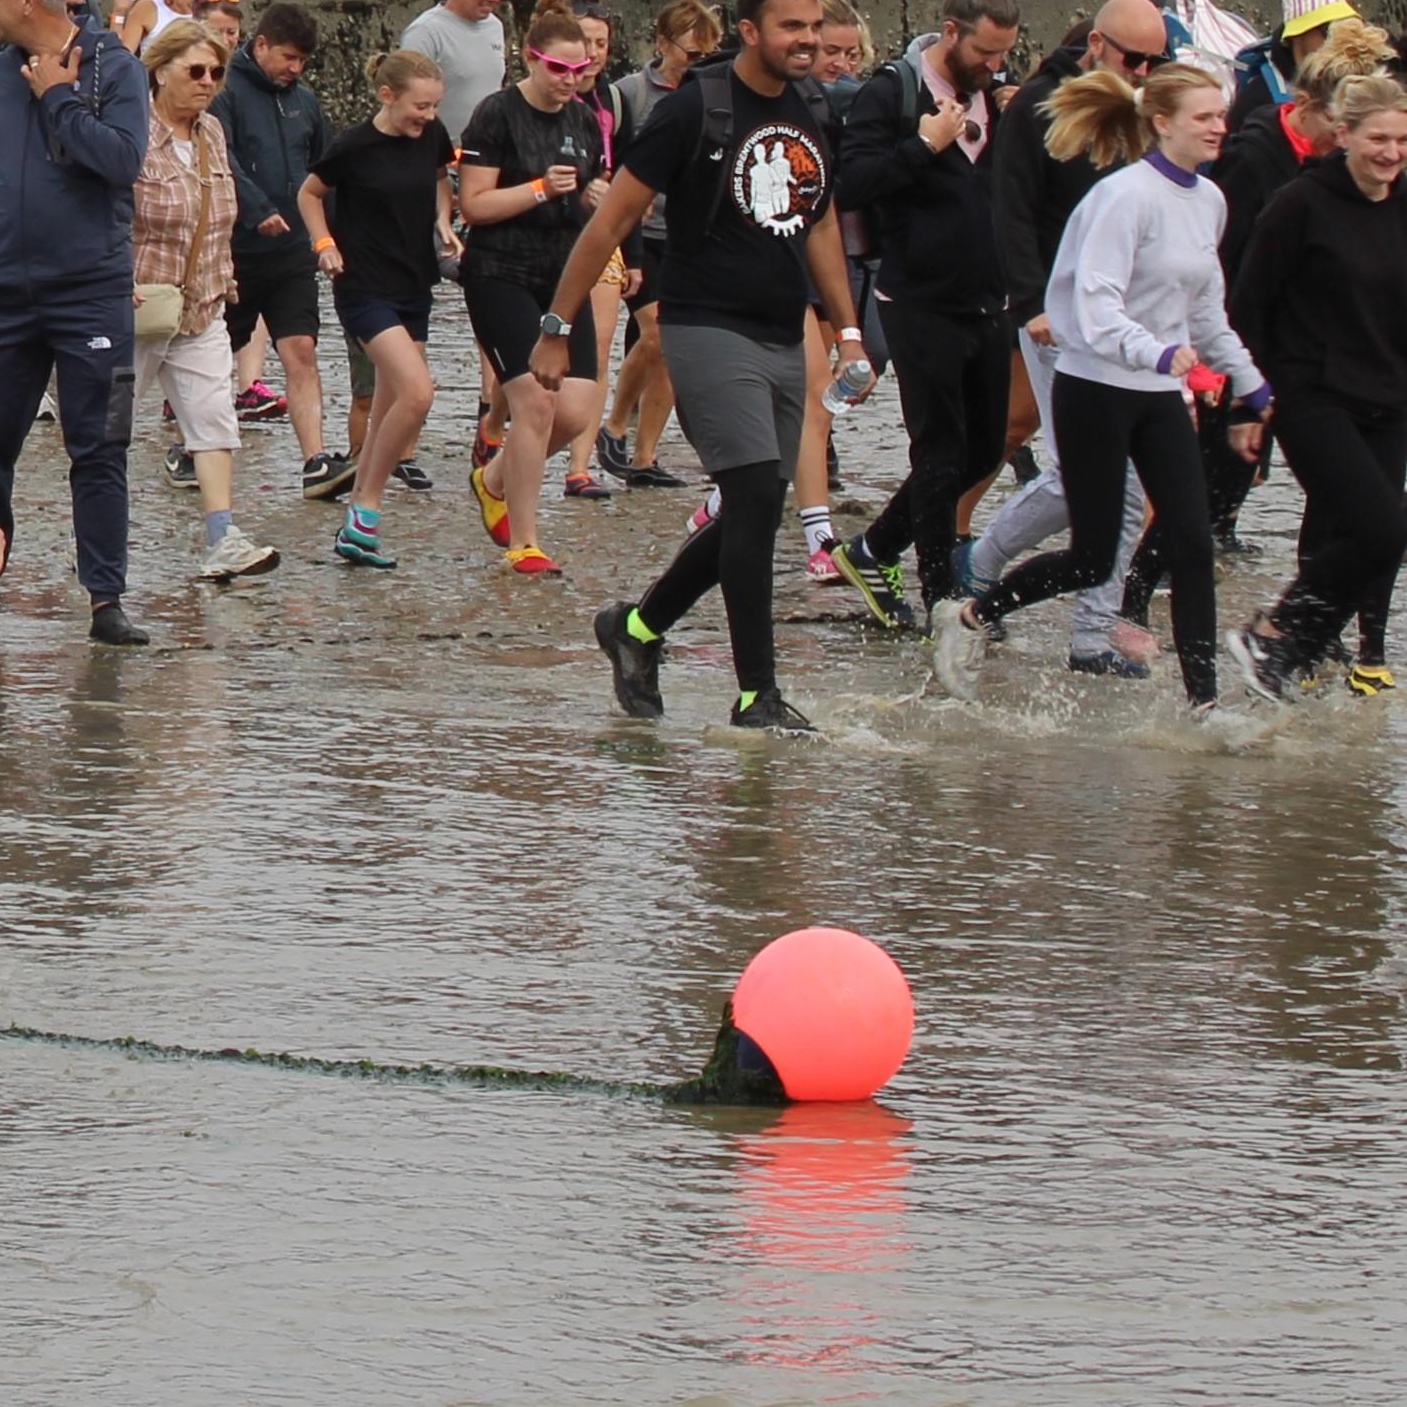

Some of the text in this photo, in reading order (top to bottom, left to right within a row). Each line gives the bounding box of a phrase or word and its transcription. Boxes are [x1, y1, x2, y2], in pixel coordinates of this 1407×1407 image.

[734, 125, 776, 174] BRENTWOOD
[776, 125, 800, 138] HALF
[799, 134, 825, 187] MARATHON
